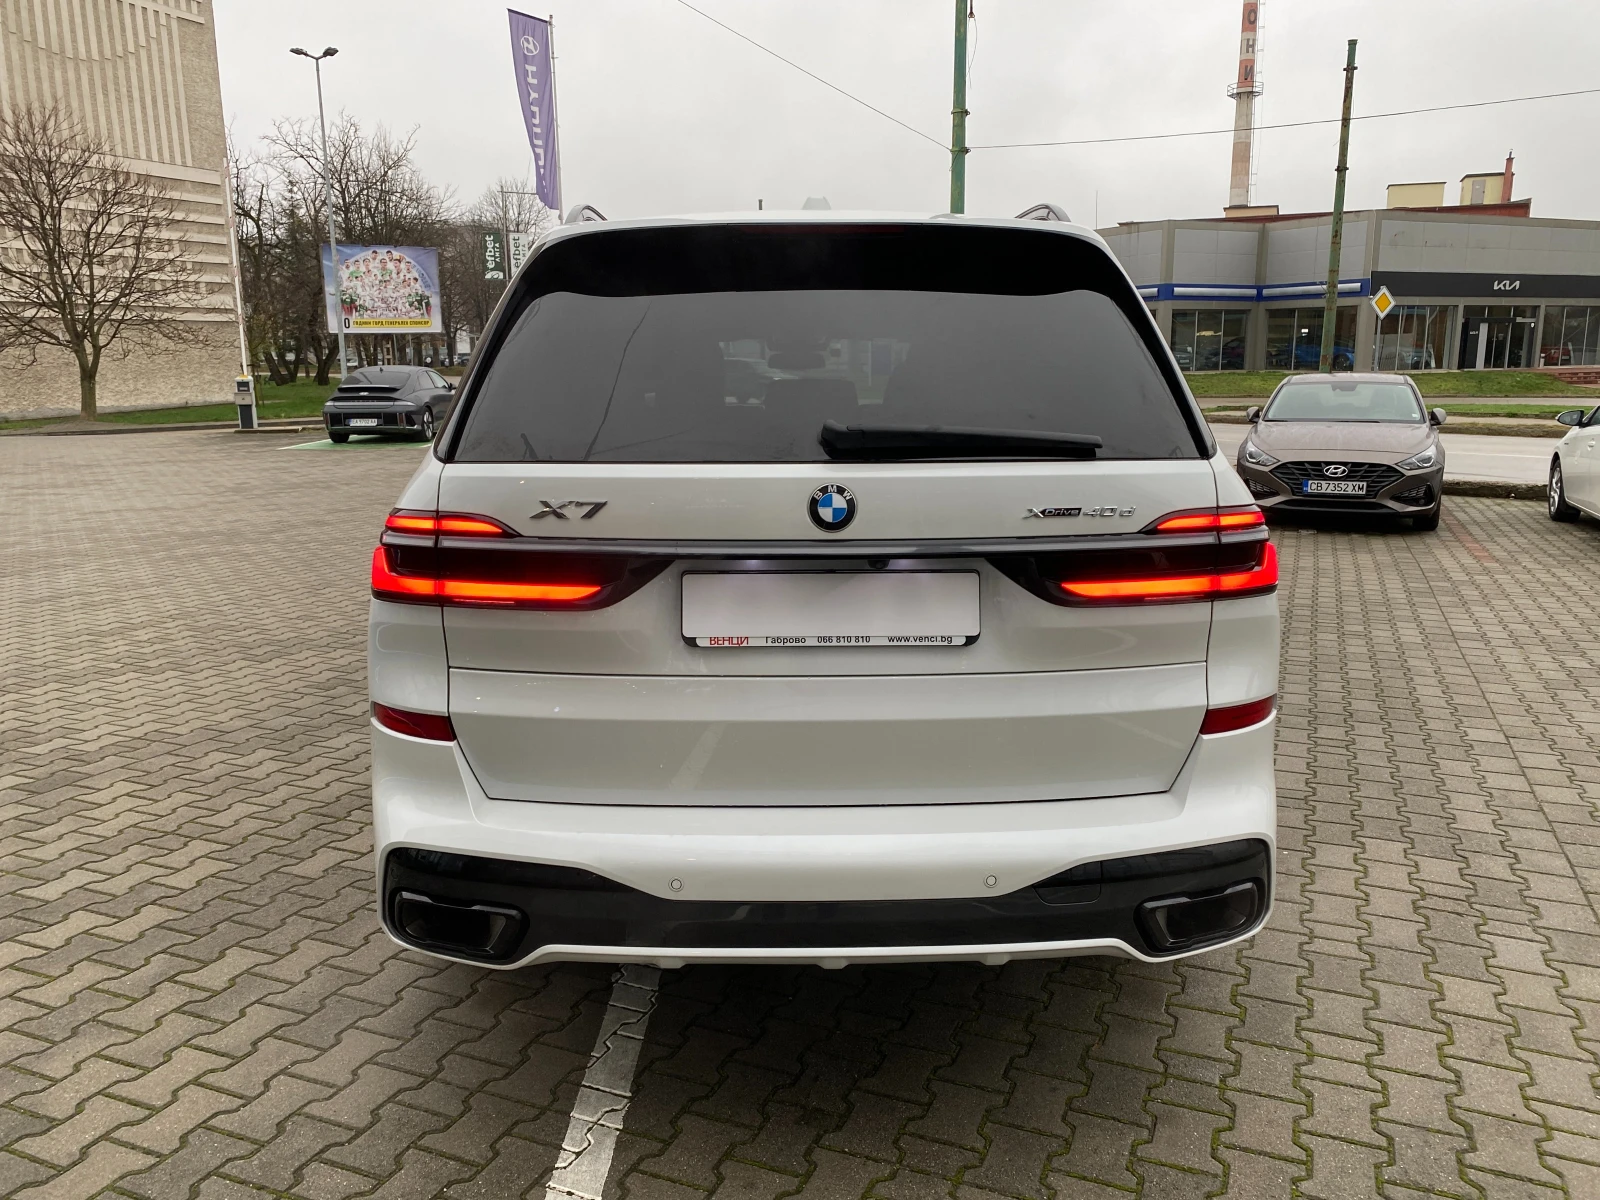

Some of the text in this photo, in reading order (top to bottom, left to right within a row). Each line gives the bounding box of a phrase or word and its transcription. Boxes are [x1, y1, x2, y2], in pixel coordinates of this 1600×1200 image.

[485, 234, 495, 269] efbet
[513, 236, 521, 269] efbet
[813, 485, 853, 500] BMW
[1325, 482, 1349, 492] 7352
[529, 500, 608, 519] X7
[709, 636, 953, 646] ВЕНЦИ Габрово 066 810 810 www.venci.bg
